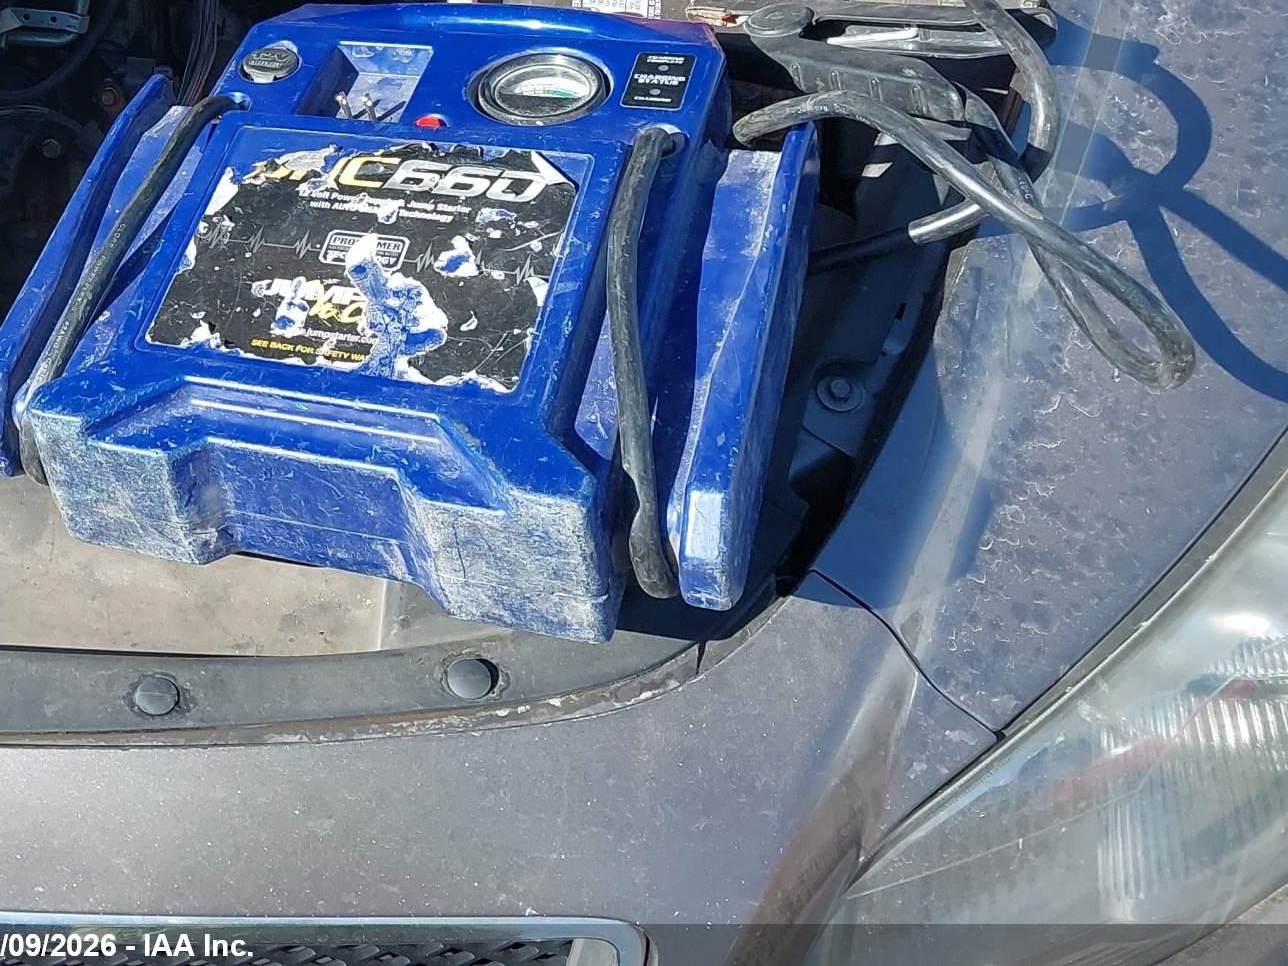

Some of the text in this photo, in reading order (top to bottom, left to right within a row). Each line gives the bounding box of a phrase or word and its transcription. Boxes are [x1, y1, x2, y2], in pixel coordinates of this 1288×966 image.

[633, 73, 687, 82] CHARGING
[310, 200, 332, 210] with
[436, 203, 472, 214] Starter
[332, 236, 402, 251] PROMER
[250, 338, 269, 348] SEE
[269, 340, 295, 352] BACK
[295, 344, 315, 354] FOR
